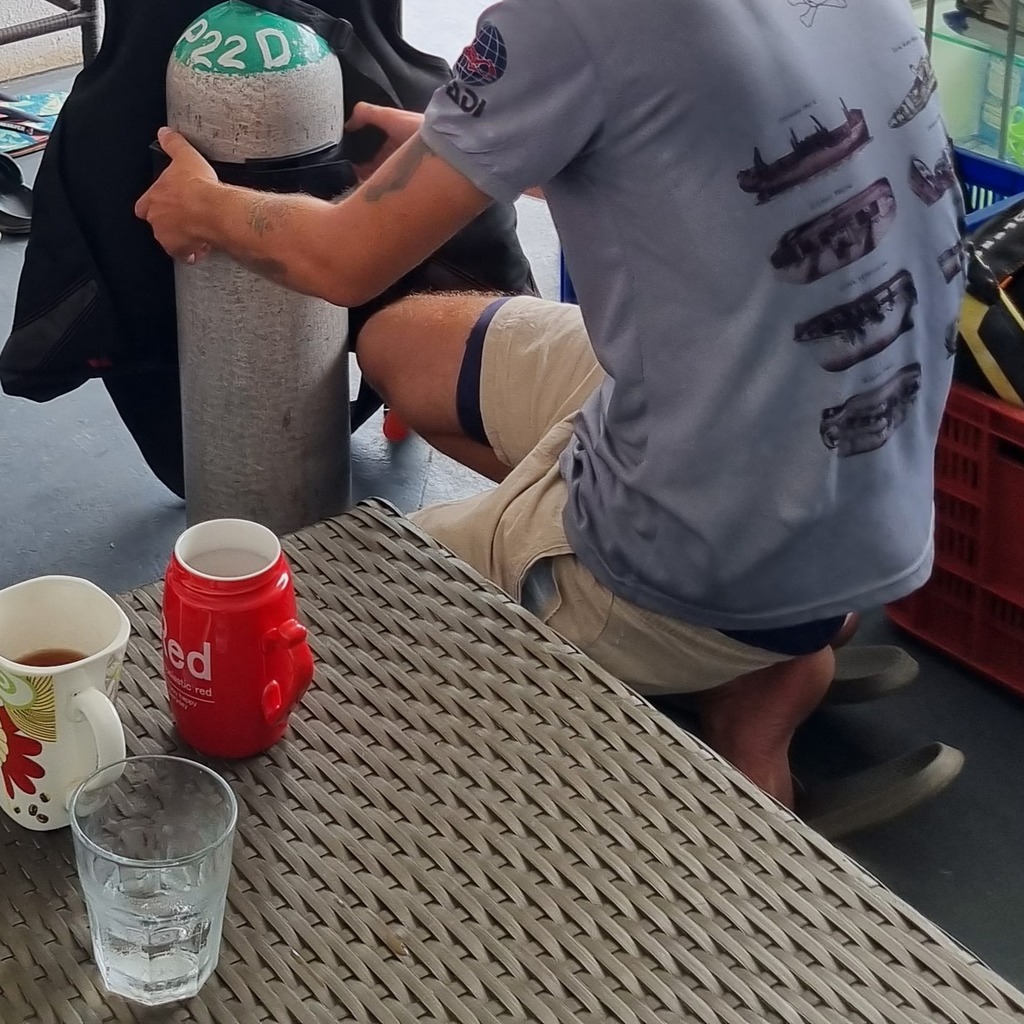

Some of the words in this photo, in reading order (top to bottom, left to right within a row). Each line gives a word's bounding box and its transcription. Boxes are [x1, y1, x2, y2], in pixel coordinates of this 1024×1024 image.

[256, 27, 291, 70] D
[162, 610, 212, 681] ed
[195, 687, 213, 697] red
